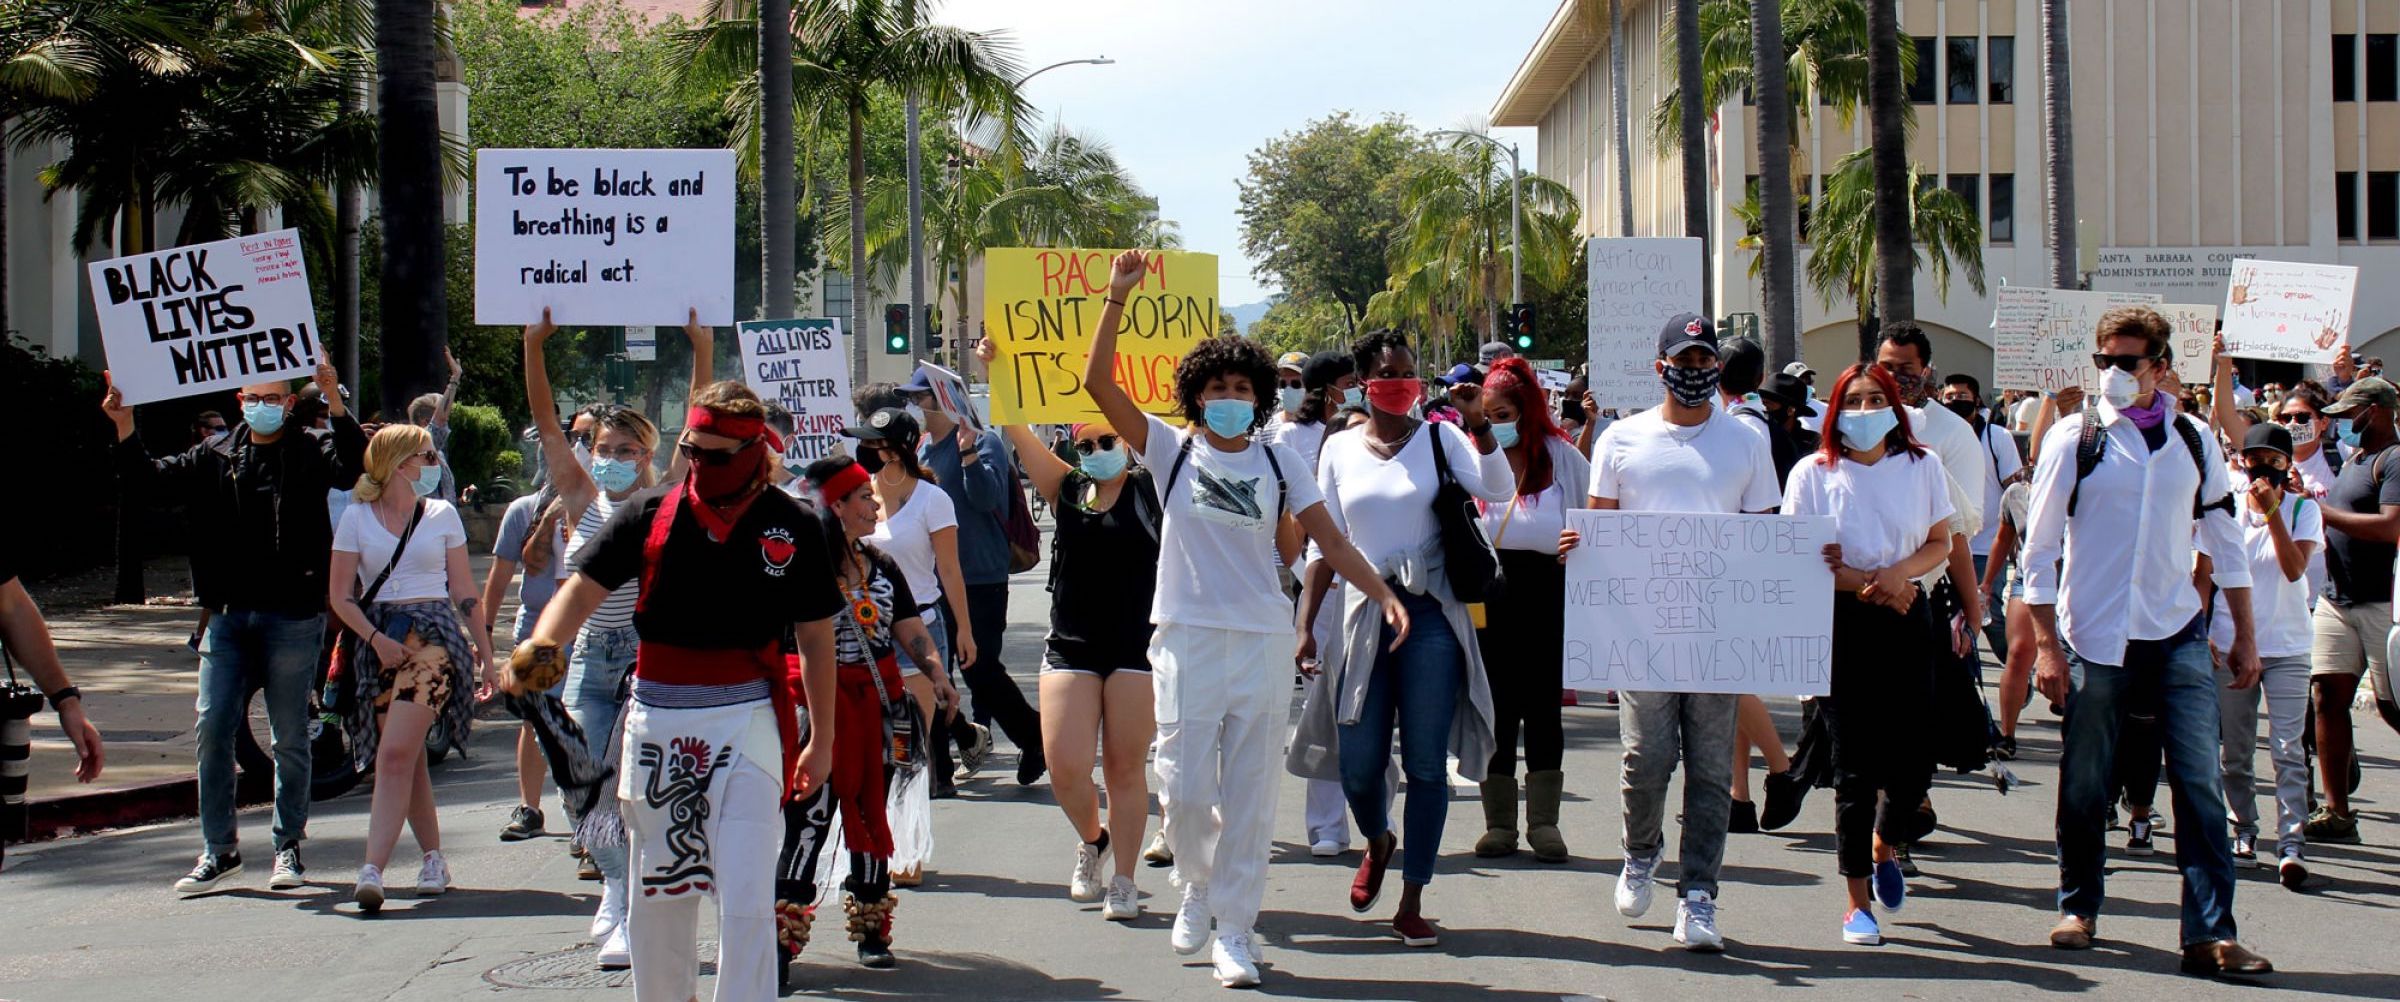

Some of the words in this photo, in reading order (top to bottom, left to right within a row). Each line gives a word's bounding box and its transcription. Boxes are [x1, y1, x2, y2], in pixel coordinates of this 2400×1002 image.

[504, 167, 536, 196] To
[547, 167, 579, 197] be
[594, 167, 656, 197] black
[668, 171, 704, 196] and
[513, 208, 616, 246] breathing
[626, 213, 645, 234] is
[656, 216, 668, 233] a
[521, 260, 587, 285] radical
[601, 258, 638, 283] act.
[1593, 248, 1672, 272] African
[2098, 254, 2131, 263] SANTA
[2145, 254, 2192, 263] BARBARA
[103, 249, 217, 306] BLACK
[1036, 251, 1166, 297] RACM
[2097, 268, 2194, 277] ADMINISTRATION
[141, 284, 256, 343] LIVES
[756, 333, 787, 353] ALL
[786, 330, 832, 351] LIVES
[2036, 320, 2073, 339] GIFT
[169, 323, 317, 385] MATTER!
[2051, 337, 2086, 354] Black
[758, 358, 801, 379] CAN'T
[1013, 351, 1081, 409] IT'S
[780, 379, 839, 398] MATTER
[1658, 517, 1736, 551] GOING
[1738, 520, 1770, 553] TO
[1775, 521, 1809, 555] BE
[1650, 551, 1727, 578] HEARD
[1645, 578, 1724, 604] GOING
[1728, 579, 1756, 604] TO
[1762, 579, 1796, 605] BE
[1655, 606, 1716, 630] SEEN
[1567, 639, 1667, 682] BLACK
[1673, 636, 1747, 682] LIVES
[1752, 635, 1831, 684] MATTER
